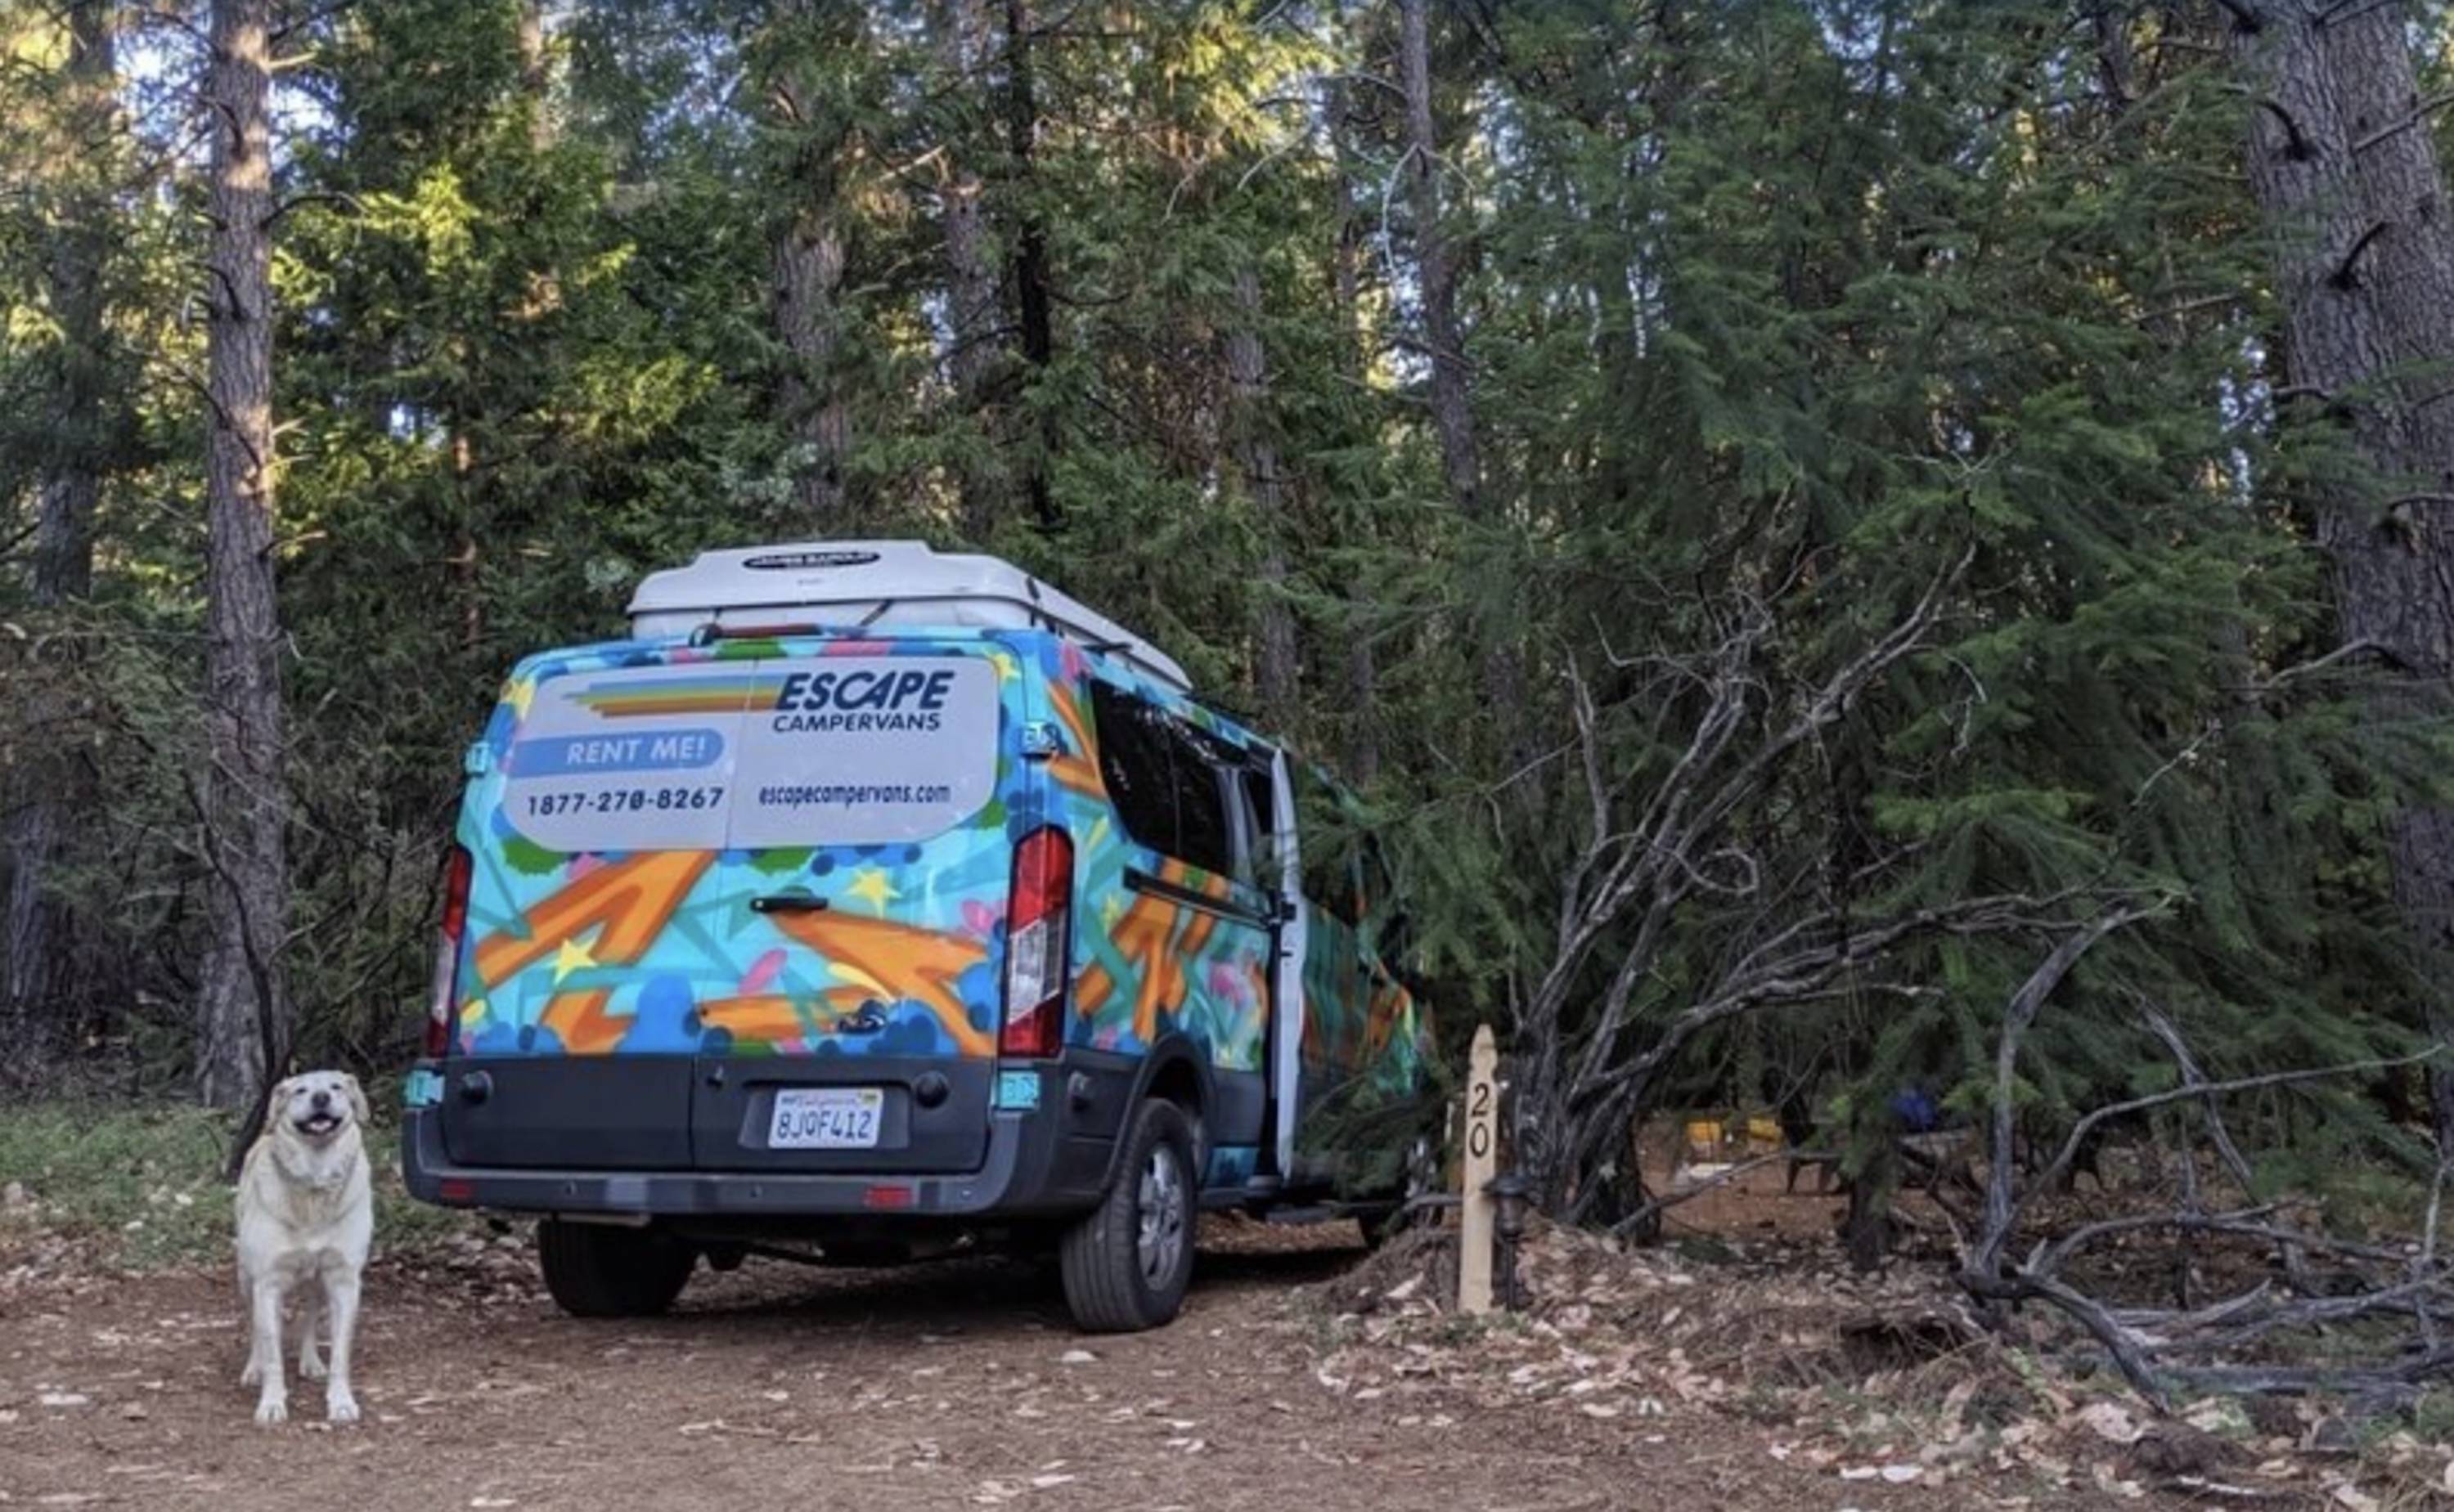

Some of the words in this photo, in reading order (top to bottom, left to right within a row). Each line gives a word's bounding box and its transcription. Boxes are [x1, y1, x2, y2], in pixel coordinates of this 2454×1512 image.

[777, 671, 955, 710] ESCAPE
[773, 713, 941, 732] CAMPERVANS
[567, 740, 640, 765] RENT
[650, 737, 706, 761] ME!
[528, 787, 724, 816] 1877-270-8267
[759, 786, 951, 810] escapecampervans.com
[1470, 1083, 1489, 1158] 20
